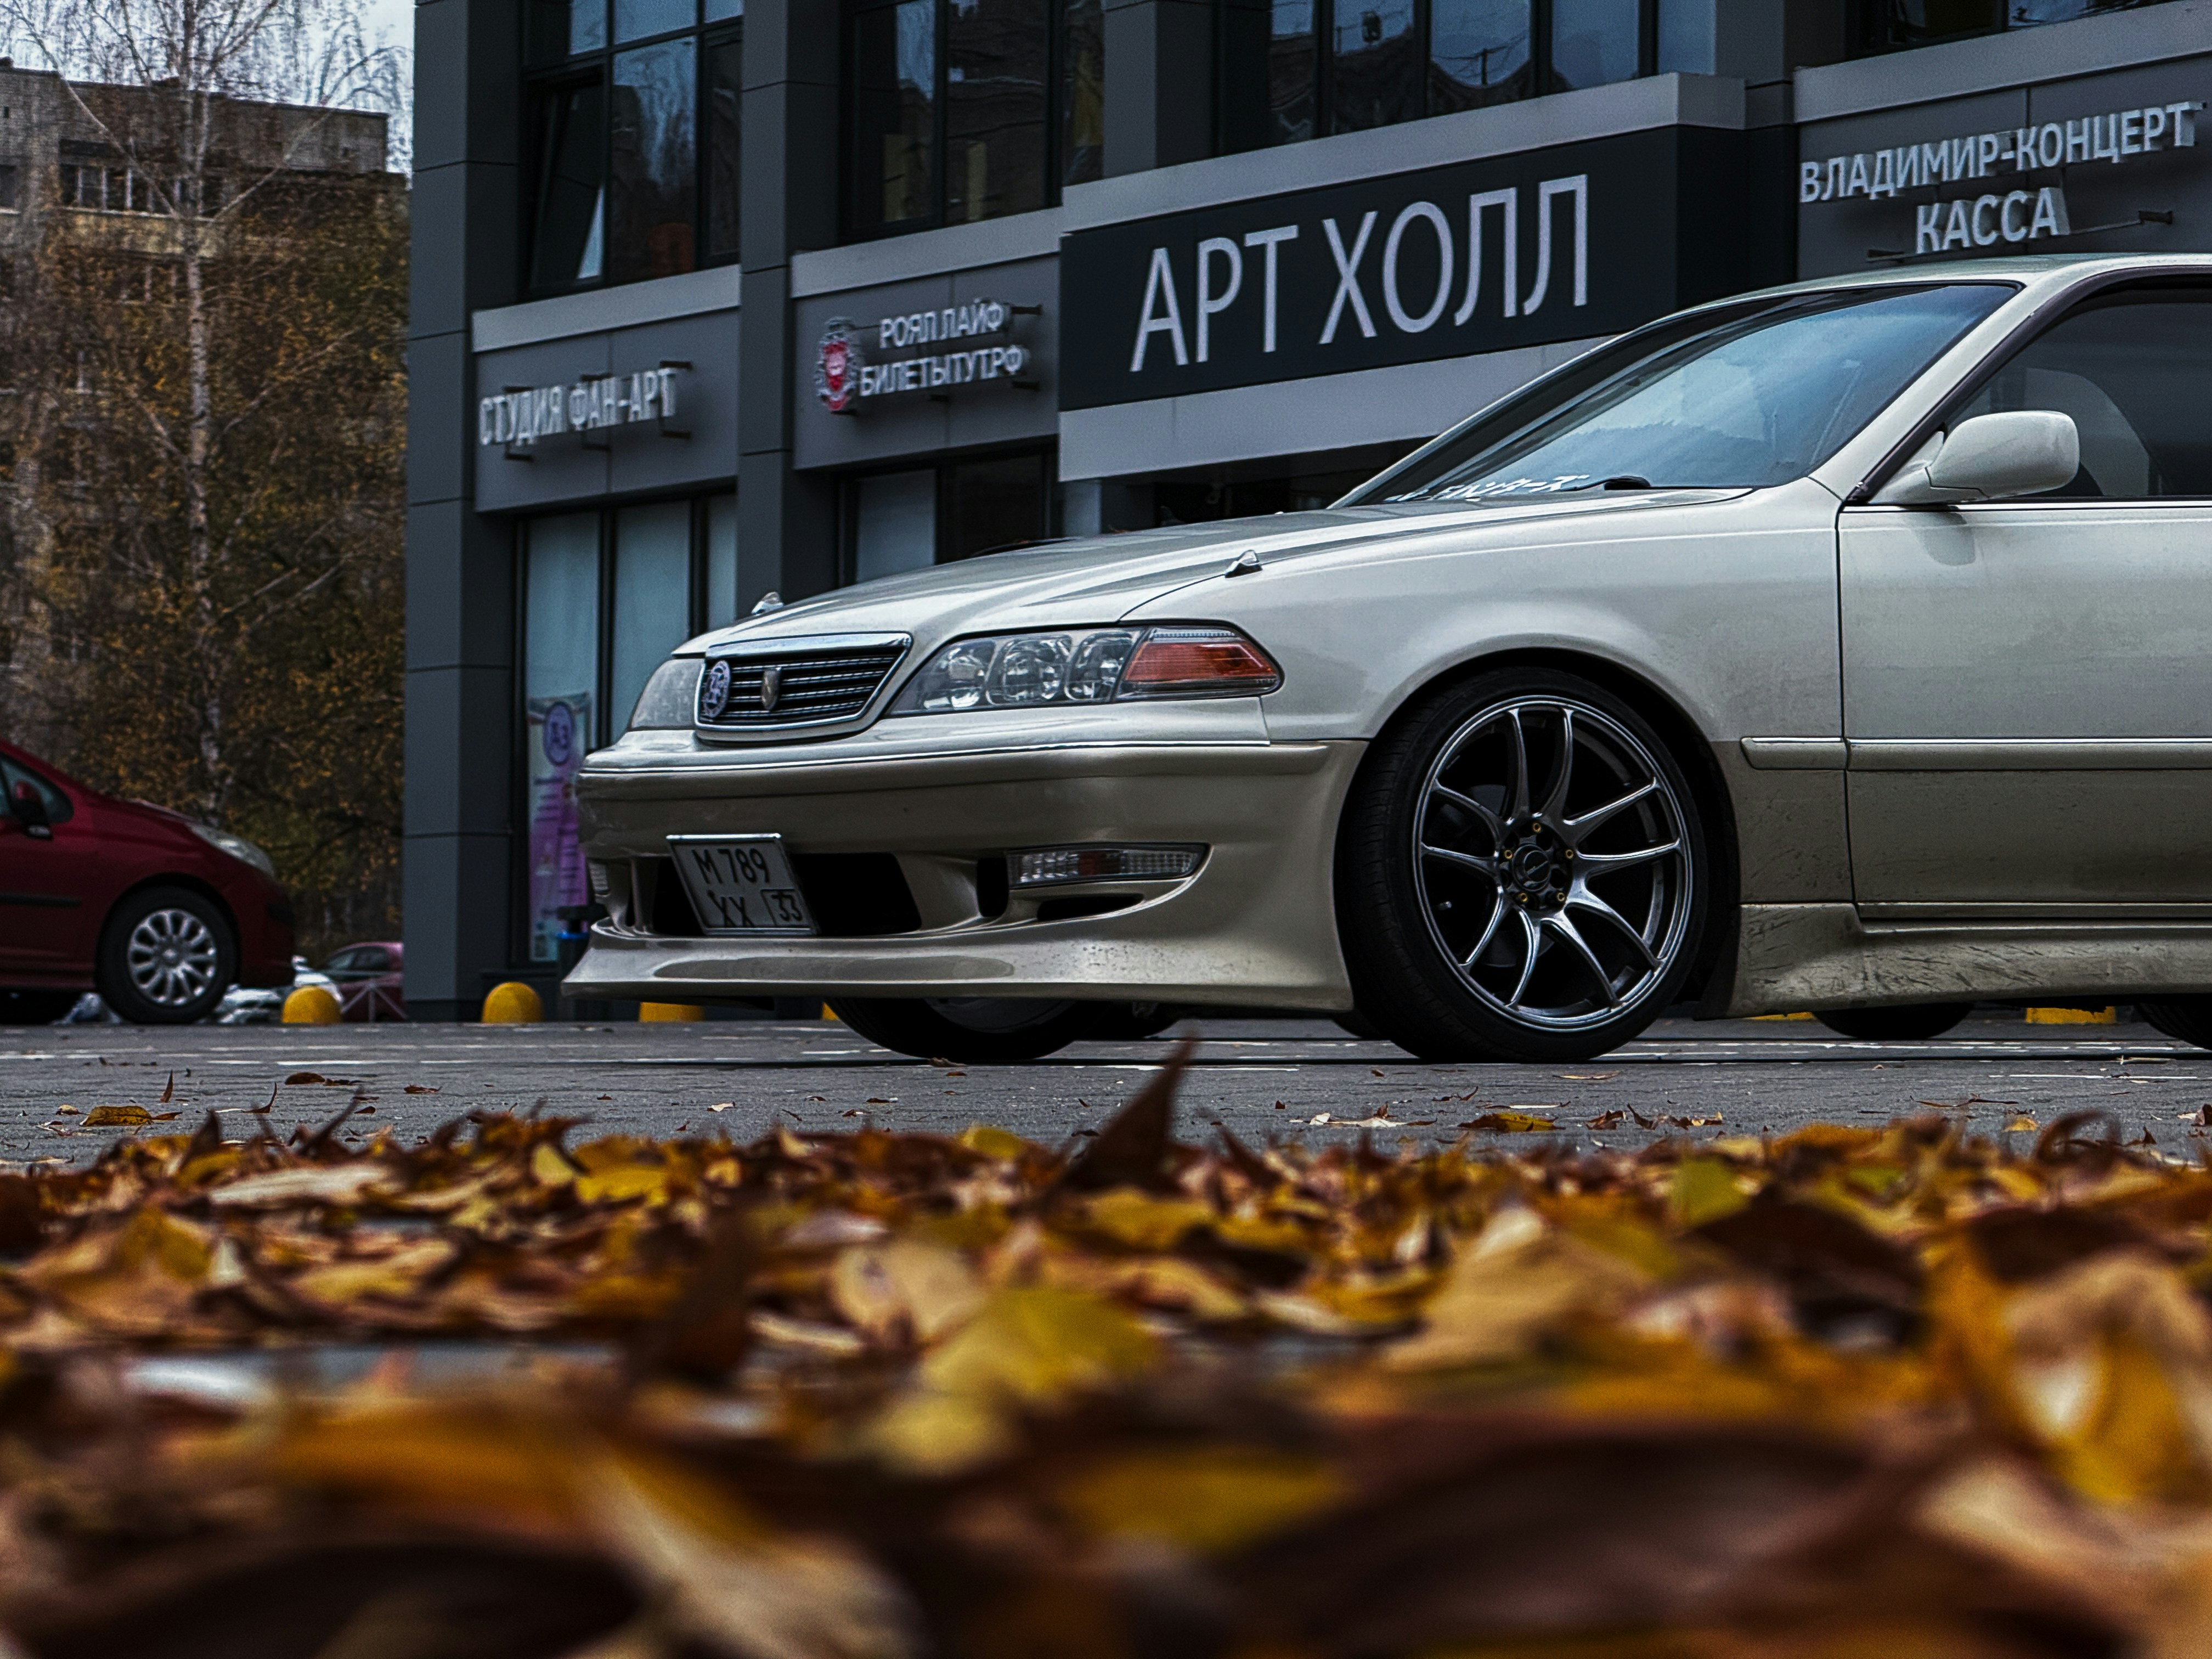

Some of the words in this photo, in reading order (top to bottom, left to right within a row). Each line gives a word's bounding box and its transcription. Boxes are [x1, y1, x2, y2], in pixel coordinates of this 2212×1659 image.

[1800, 101, 2194, 202] ВЛАДИМИР-КОНЦЕРТ
[1916, 187, 2068, 254] КАССА
[1129, 224, 1299, 372] АРТ
[1318, 174, 1588, 345] ХОЛЛ
[479, 386, 565, 447] СТУДИЯ
[568, 368, 675, 431] ФАН-АРТ
